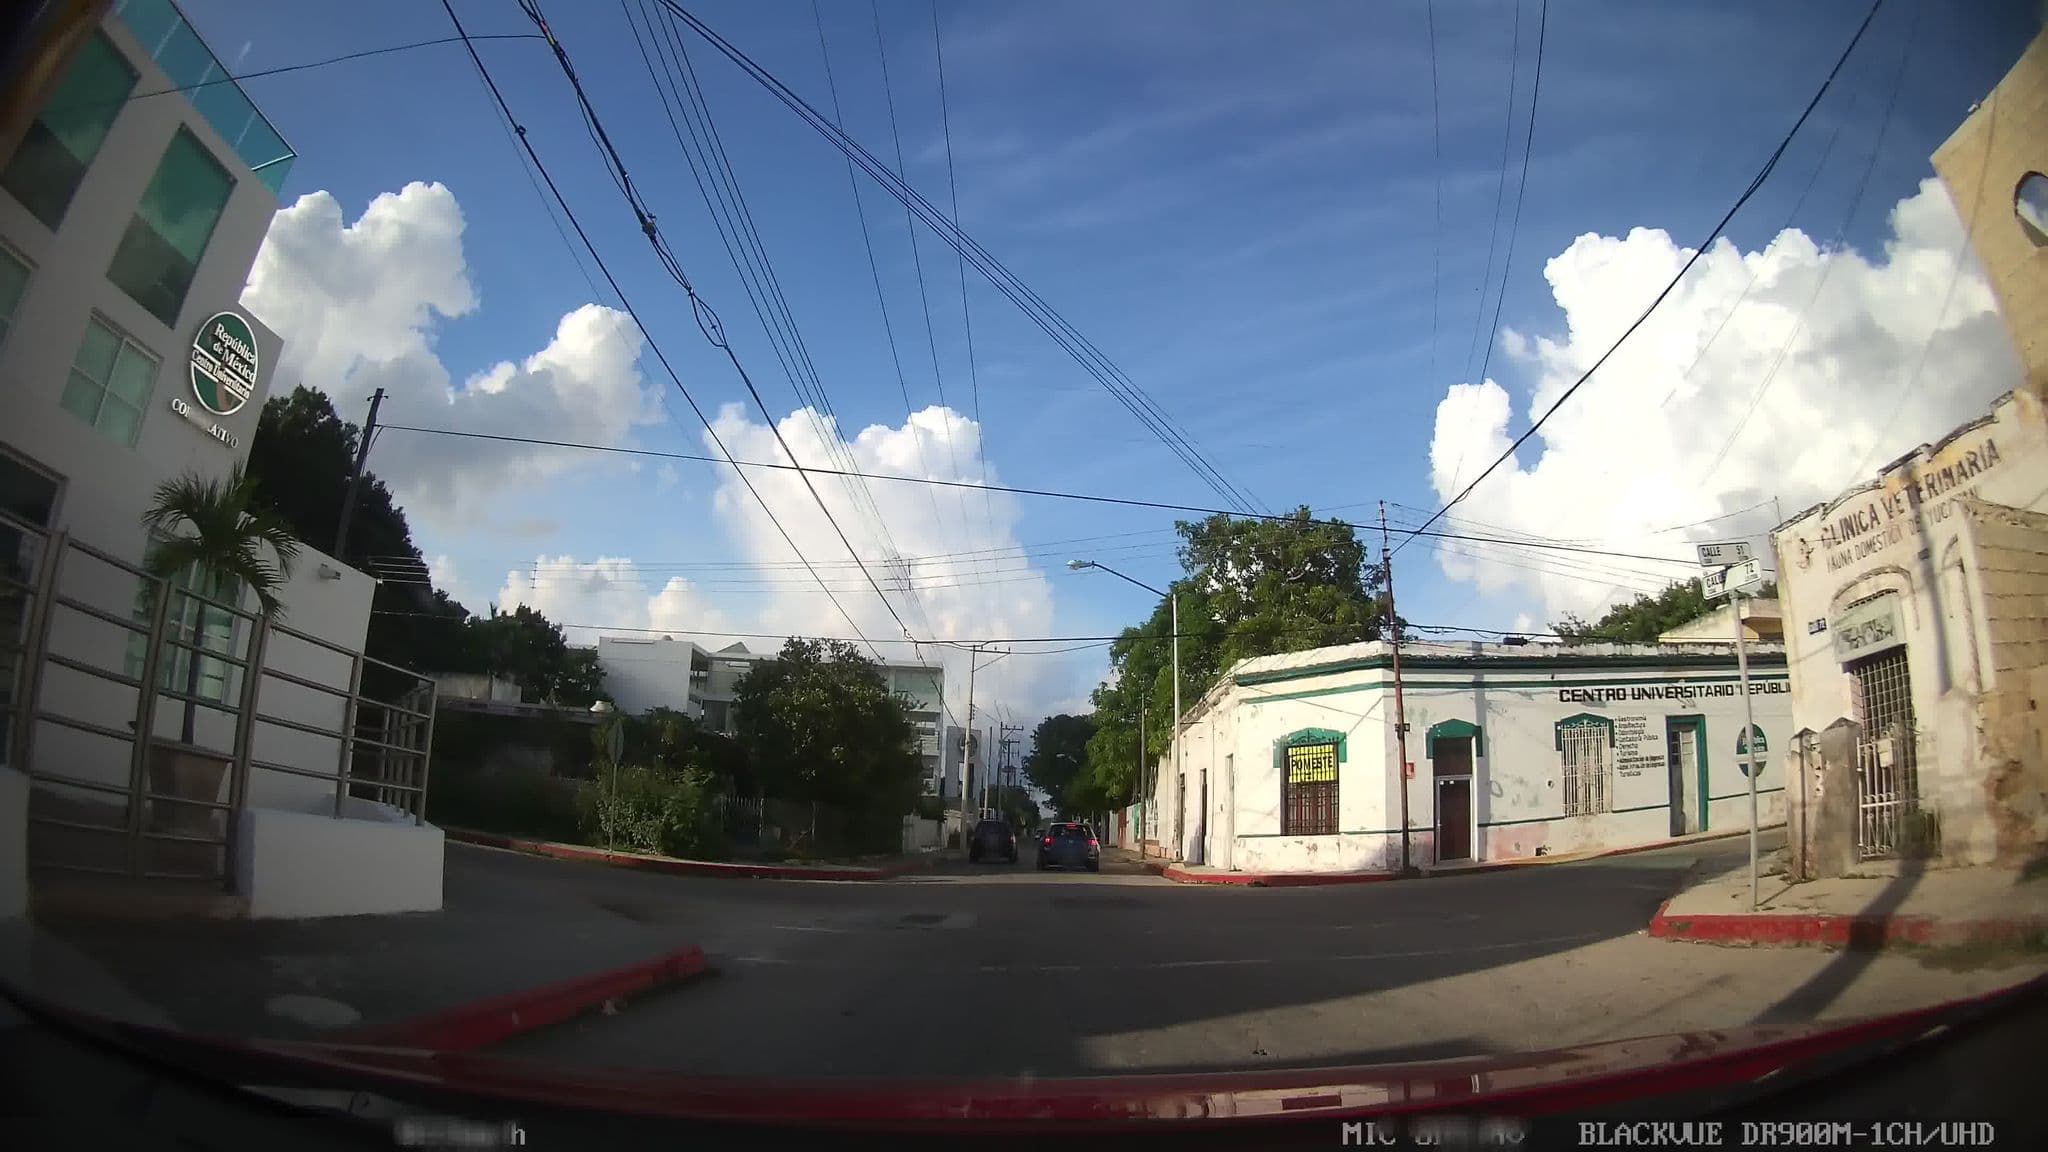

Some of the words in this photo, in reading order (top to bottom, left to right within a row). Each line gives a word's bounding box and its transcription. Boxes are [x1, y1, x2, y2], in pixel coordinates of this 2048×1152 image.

[213, 342, 223, 355] de
[221, 348, 255, 382] México
[214, 323, 256, 365] República
[191, 349, 213, 373] Centro
[212, 365, 250, 399] Universitario
[172, 398, 239, 448] COATIVO
[1880, 438, 2000, 520] VETERINARIA
[1701, 546, 1722, 557] CALLE
[1744, 562, 1754, 575] 72
[1559, 688, 1626, 703] CENTRO
[1631, 684, 1734, 701] UNIVERSITARIO
